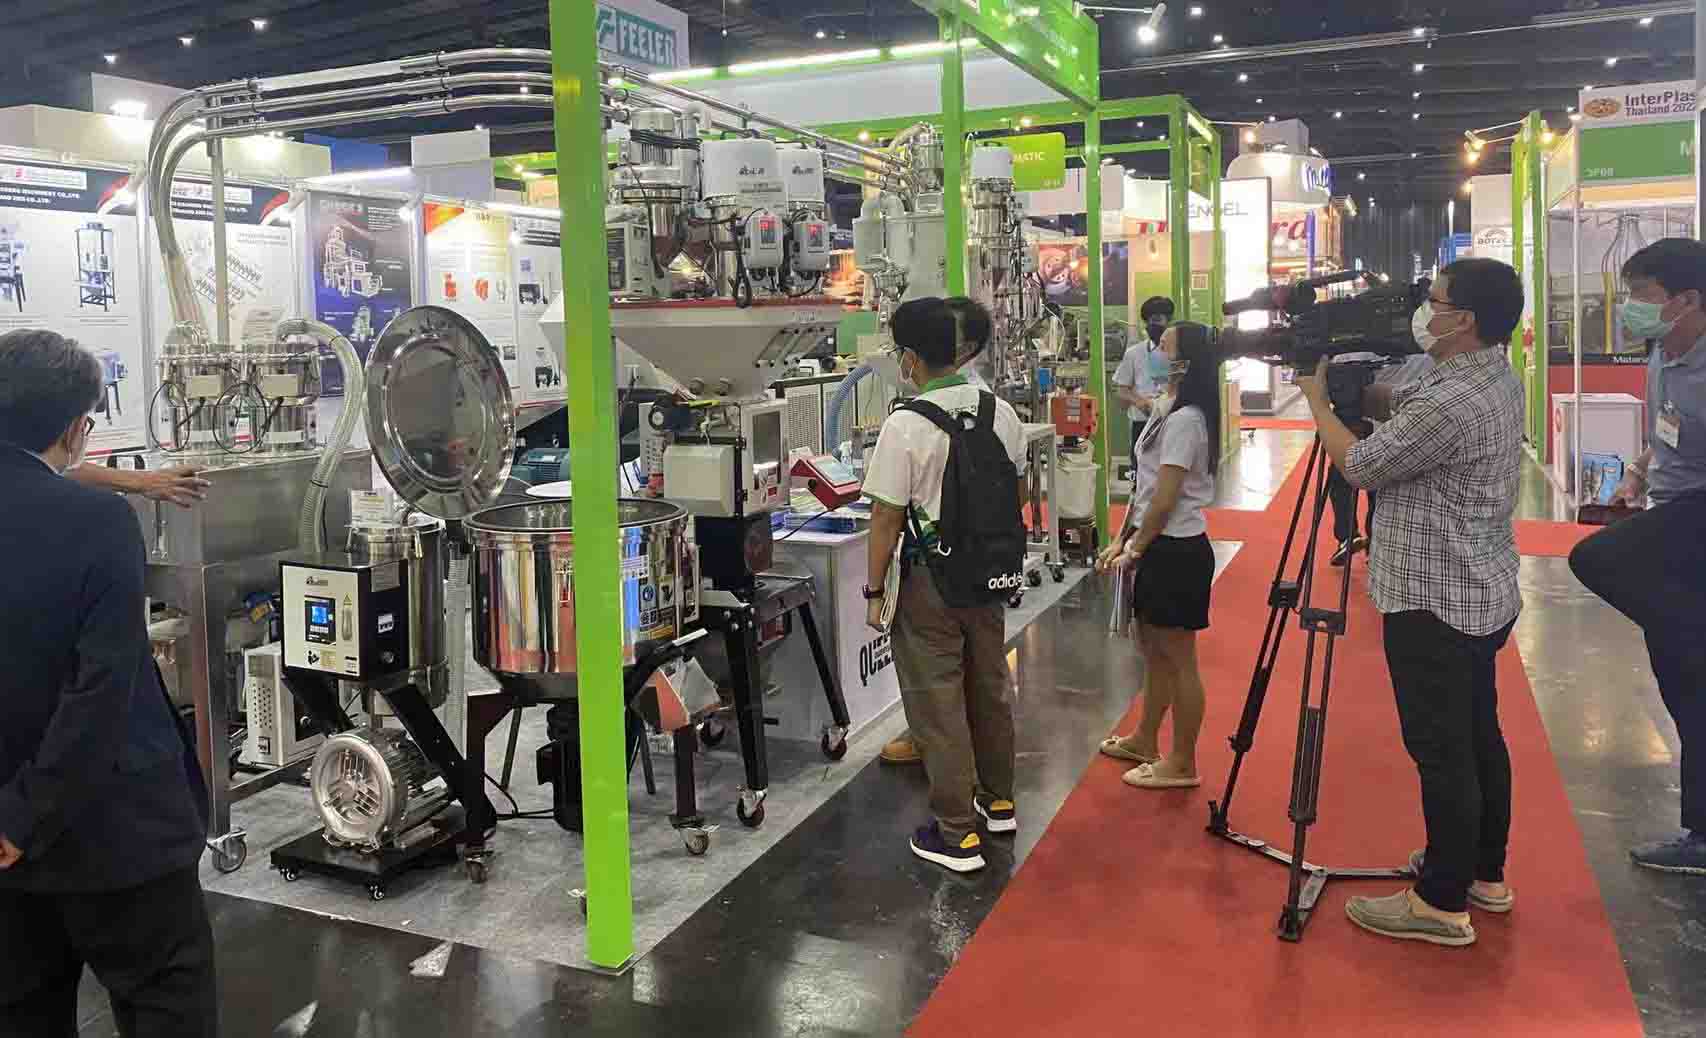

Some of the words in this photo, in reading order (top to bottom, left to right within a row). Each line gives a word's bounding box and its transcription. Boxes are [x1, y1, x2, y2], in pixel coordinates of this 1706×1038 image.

[620, 17, 673, 64] FEELER
[1625, 104, 1669, 117] Thailand
[1188, 201, 1249, 218] ENEL
